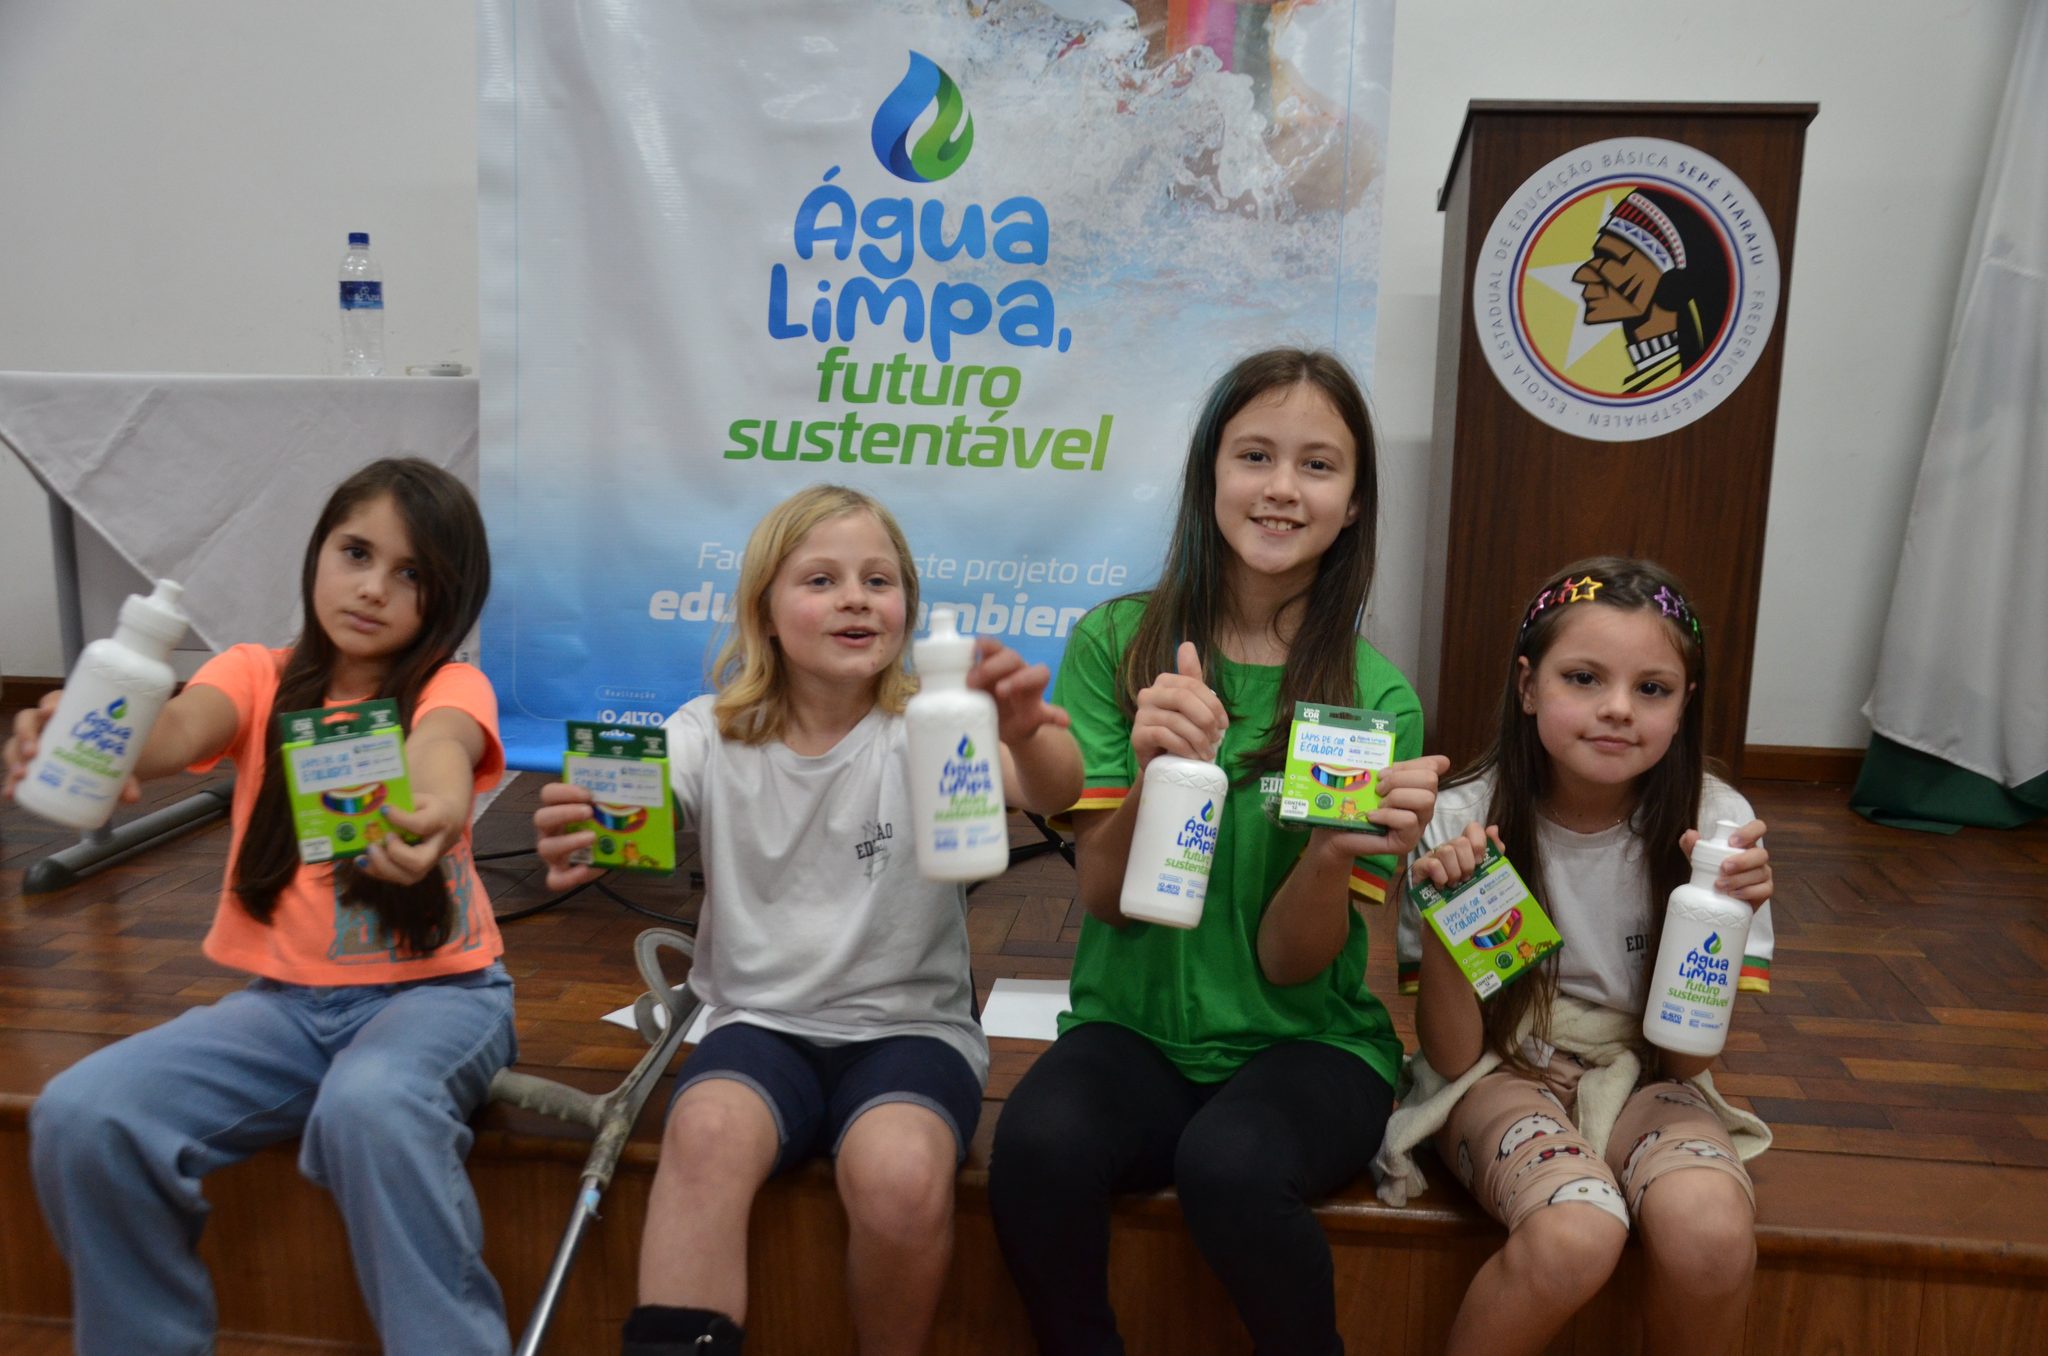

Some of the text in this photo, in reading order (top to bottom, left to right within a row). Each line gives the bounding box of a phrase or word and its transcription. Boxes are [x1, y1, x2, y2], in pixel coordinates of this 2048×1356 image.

[1602, 150, 1668, 168] BÁSICA
[1679, 161, 1720, 190] SEPÉ
[1508, 160, 1592, 232] EDUCAÇÃO
[794, 165, 1050, 279] Água
[1495, 238, 1513, 260] DE
[767, 263, 1072, 362] Limpa,
[1489, 270, 1514, 360] ESTADUAL
[816, 347, 1022, 409] futuro
[1588, 290, 1765, 426] FREDERICO WESTPHALEN
[1513, 365, 1567, 414] ESCOLA
[723, 411, 1113, 471] sustentável
[962, 554, 1078, 588] projeto
[1087, 556, 1127, 588] de
[1185, 816, 1217, 839] Água
[1686, 947, 1729, 971] Água
[1685, 979, 1720, 996] futuro
